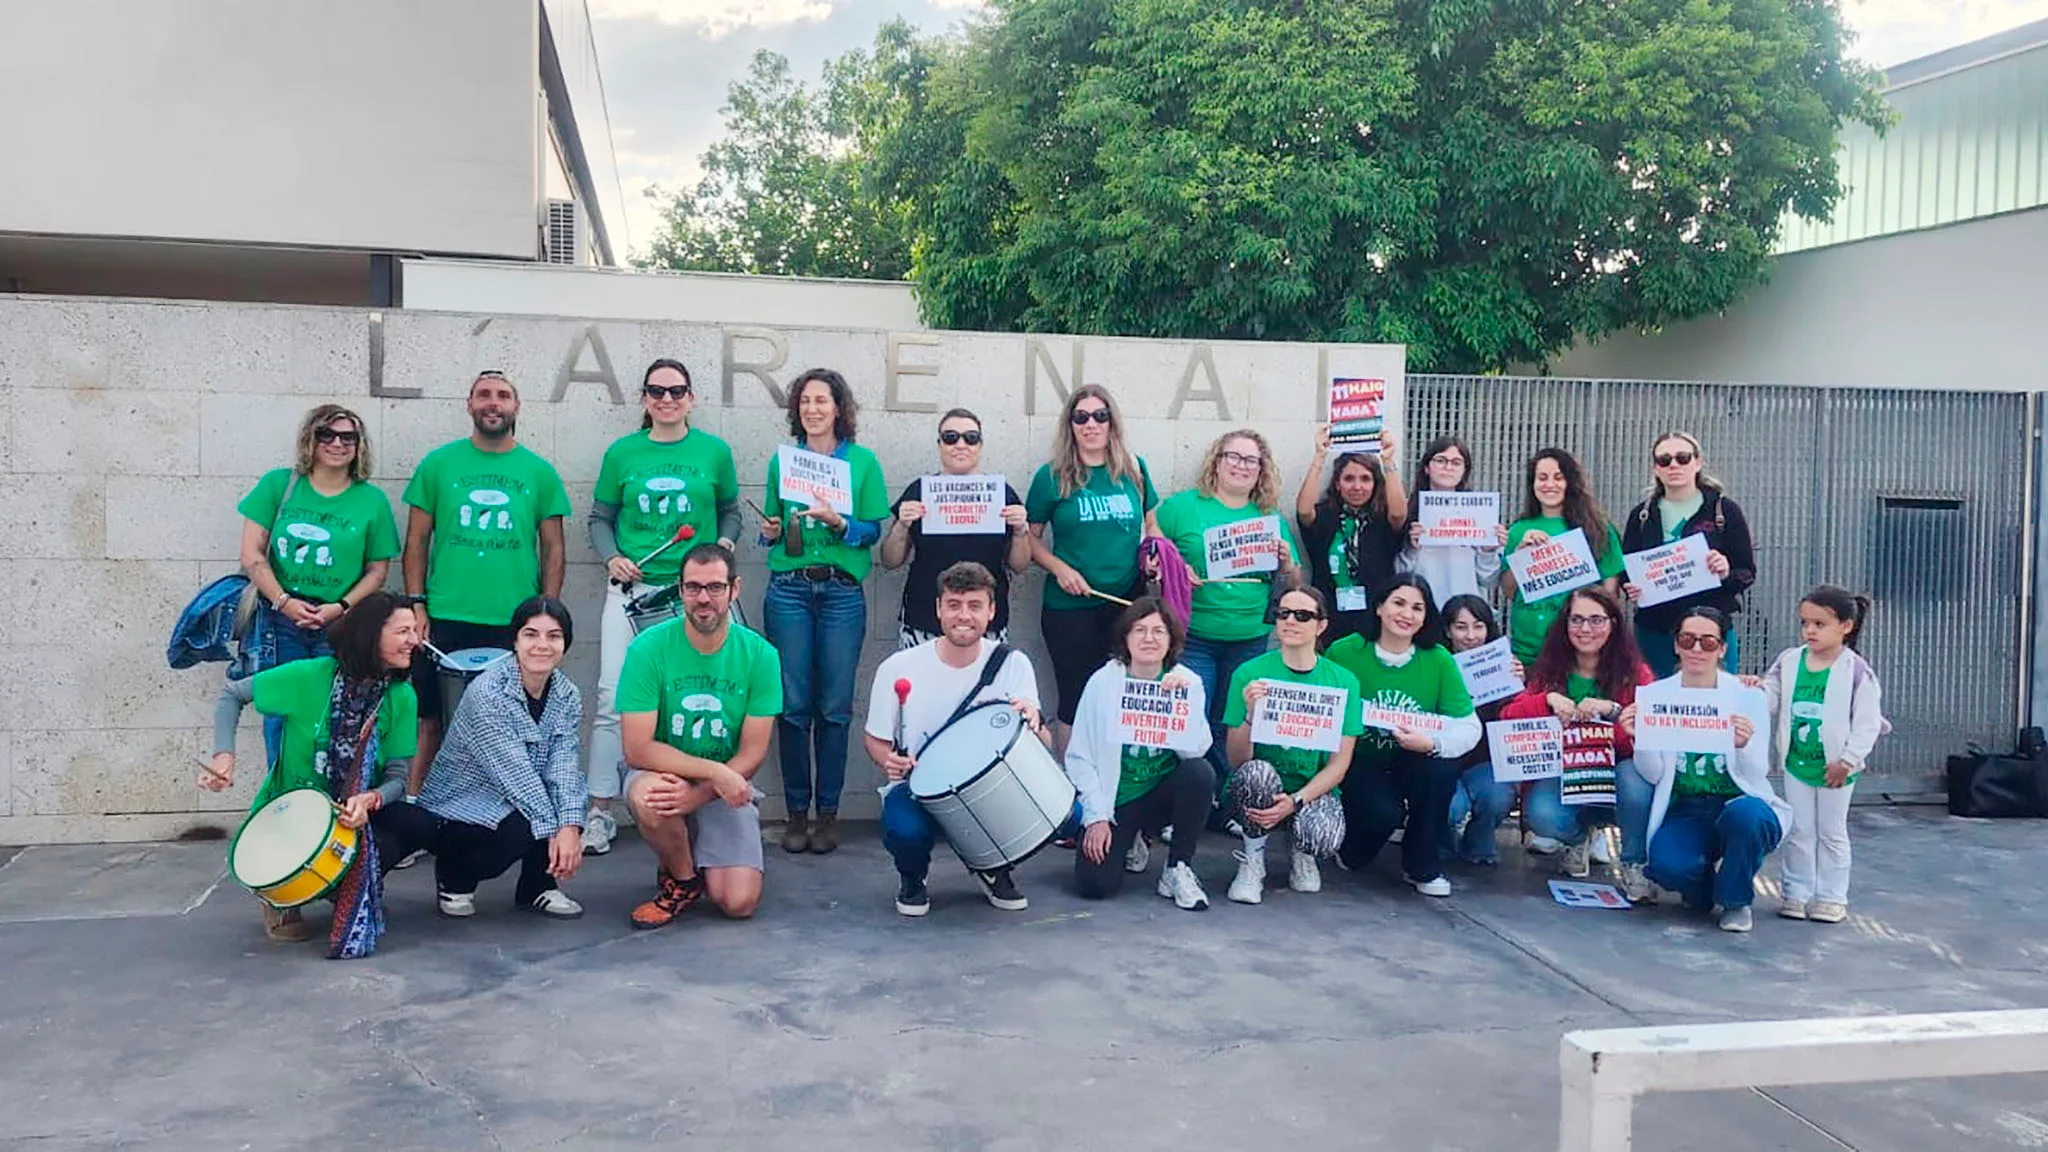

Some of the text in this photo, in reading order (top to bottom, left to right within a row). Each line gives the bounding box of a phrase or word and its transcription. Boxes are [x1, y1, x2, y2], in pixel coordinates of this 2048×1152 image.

[929, 482, 942, 492] LES
[986, 482, 997, 491] NO
[983, 494, 992, 502] LA
[1424, 496, 1458, 506] DOCENTS
[1218, 529, 1228, 539] LA
[1221, 549, 1237, 560] UNA
[1531, 543, 1564, 561] MENYS
[1522, 578, 1545, 593] MÉS
[1125, 681, 1189, 700] INVERTIR EN
[1308, 692, 1317, 703] EL
[1266, 699, 1277, 710] DE
[1327, 707, 1334, 717] A
[1652, 703, 1719, 717] SIN INVERSIÓN
[1122, 712, 1185, 731] INVERTIR EN
[1263, 711, 1279, 721] UNA
[1322, 718, 1333, 729] DE
[1643, 715, 1657, 726] NO
[1659, 715, 1677, 727] HAY
[1563, 727, 1581, 745] 11
